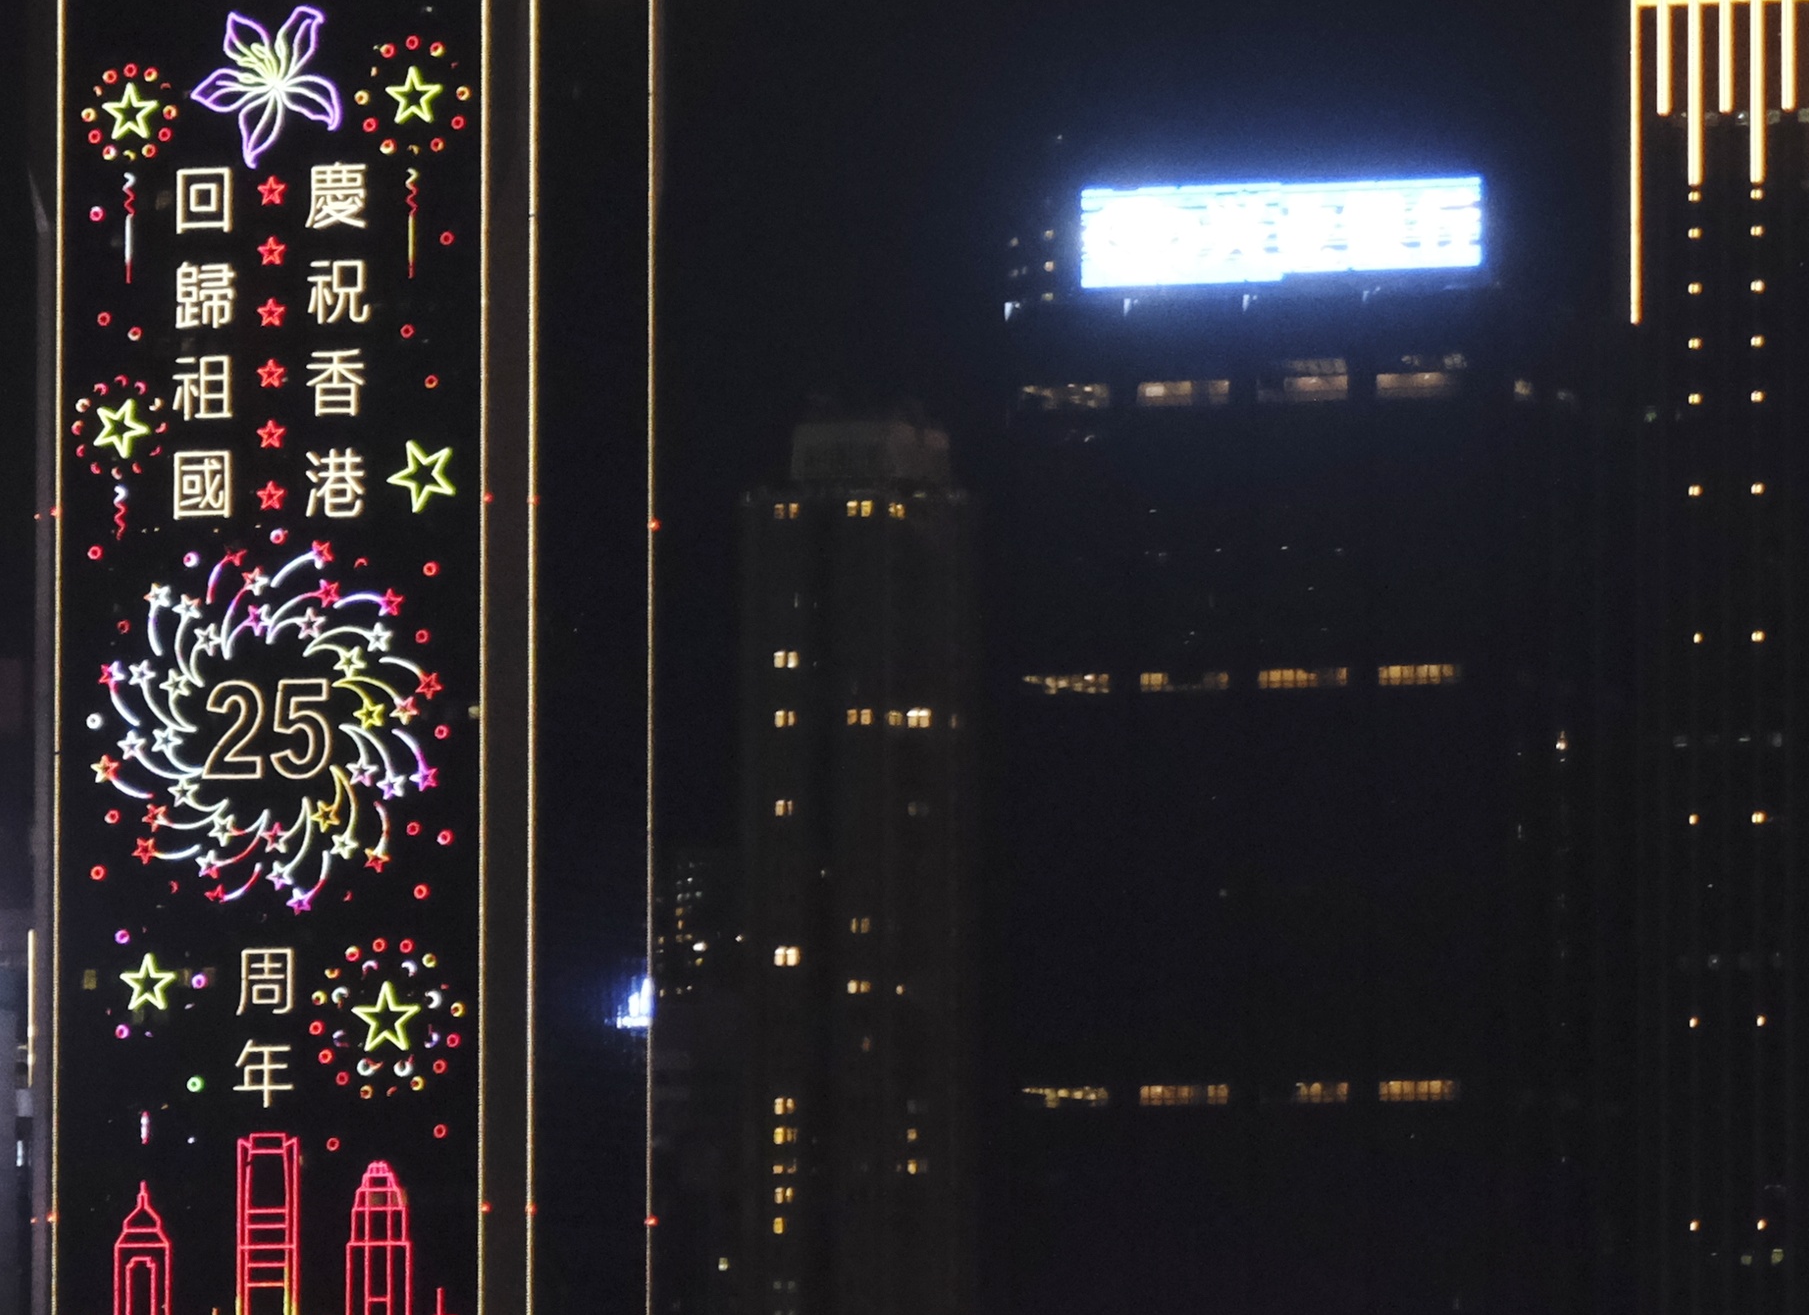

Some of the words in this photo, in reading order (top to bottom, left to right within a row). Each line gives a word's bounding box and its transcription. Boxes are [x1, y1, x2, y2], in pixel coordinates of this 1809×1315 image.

[172, 165, 235, 521] 回歸祖國
[305, 161, 370, 520] 慶祝香港
[202, 677, 333, 781] 25
[232, 946, 295, 1110] 周年
